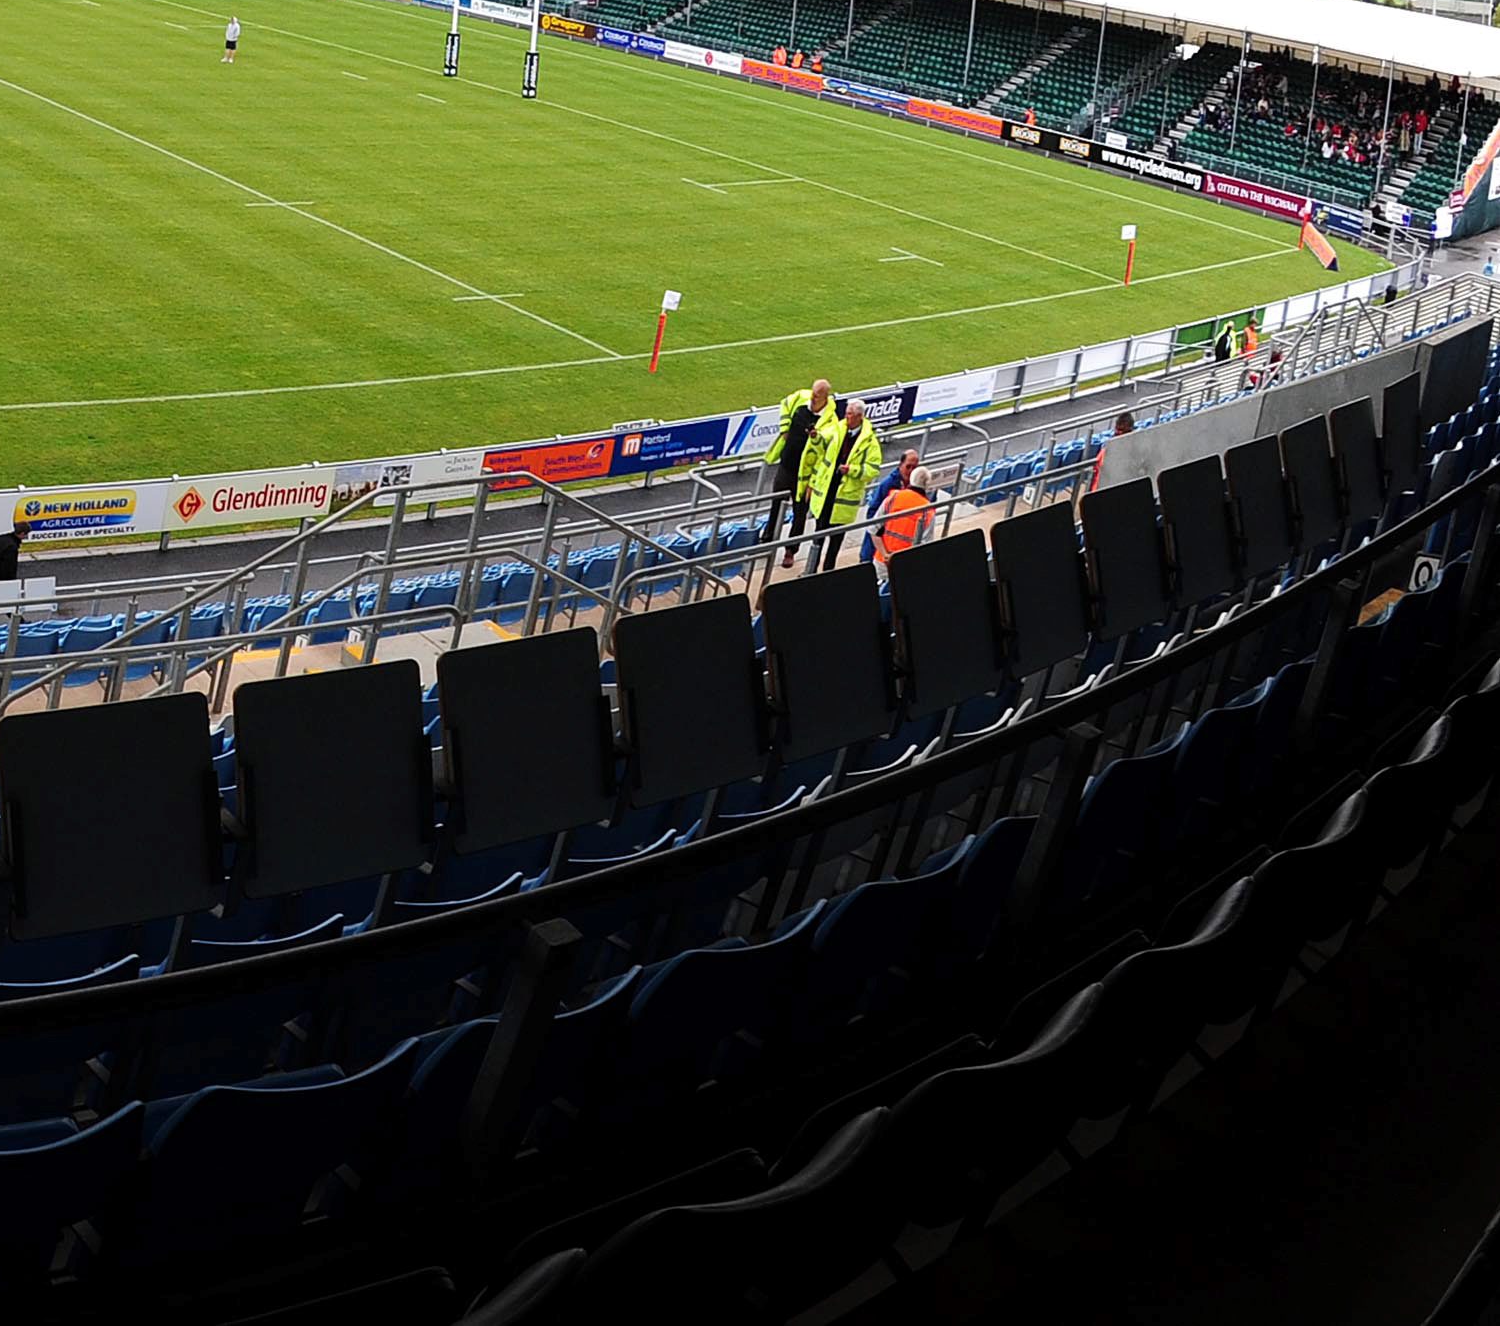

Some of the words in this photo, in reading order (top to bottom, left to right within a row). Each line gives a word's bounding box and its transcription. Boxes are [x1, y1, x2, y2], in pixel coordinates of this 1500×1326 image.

[551, 16, 585, 32] Gregory
[1101, 149, 1202, 191] www.recycledevon.org
[1216, 181, 1240, 196] OTTER
[1240, 186, 1250, 199] IN
[1250, 189, 1263, 203] THE
[43, 501, 72, 514] NEW
[73, 498, 129, 511] HOLLAND
[211, 480, 329, 514] Glendinning
[40, 515, 107, 529] AGRICULTURE
[32, 531, 68, 541] SUCCESS
[74, 529, 92, 537] OUR
[93, 526, 136, 536] SPECIALTY
[1414, 557, 1436, 588] Q
